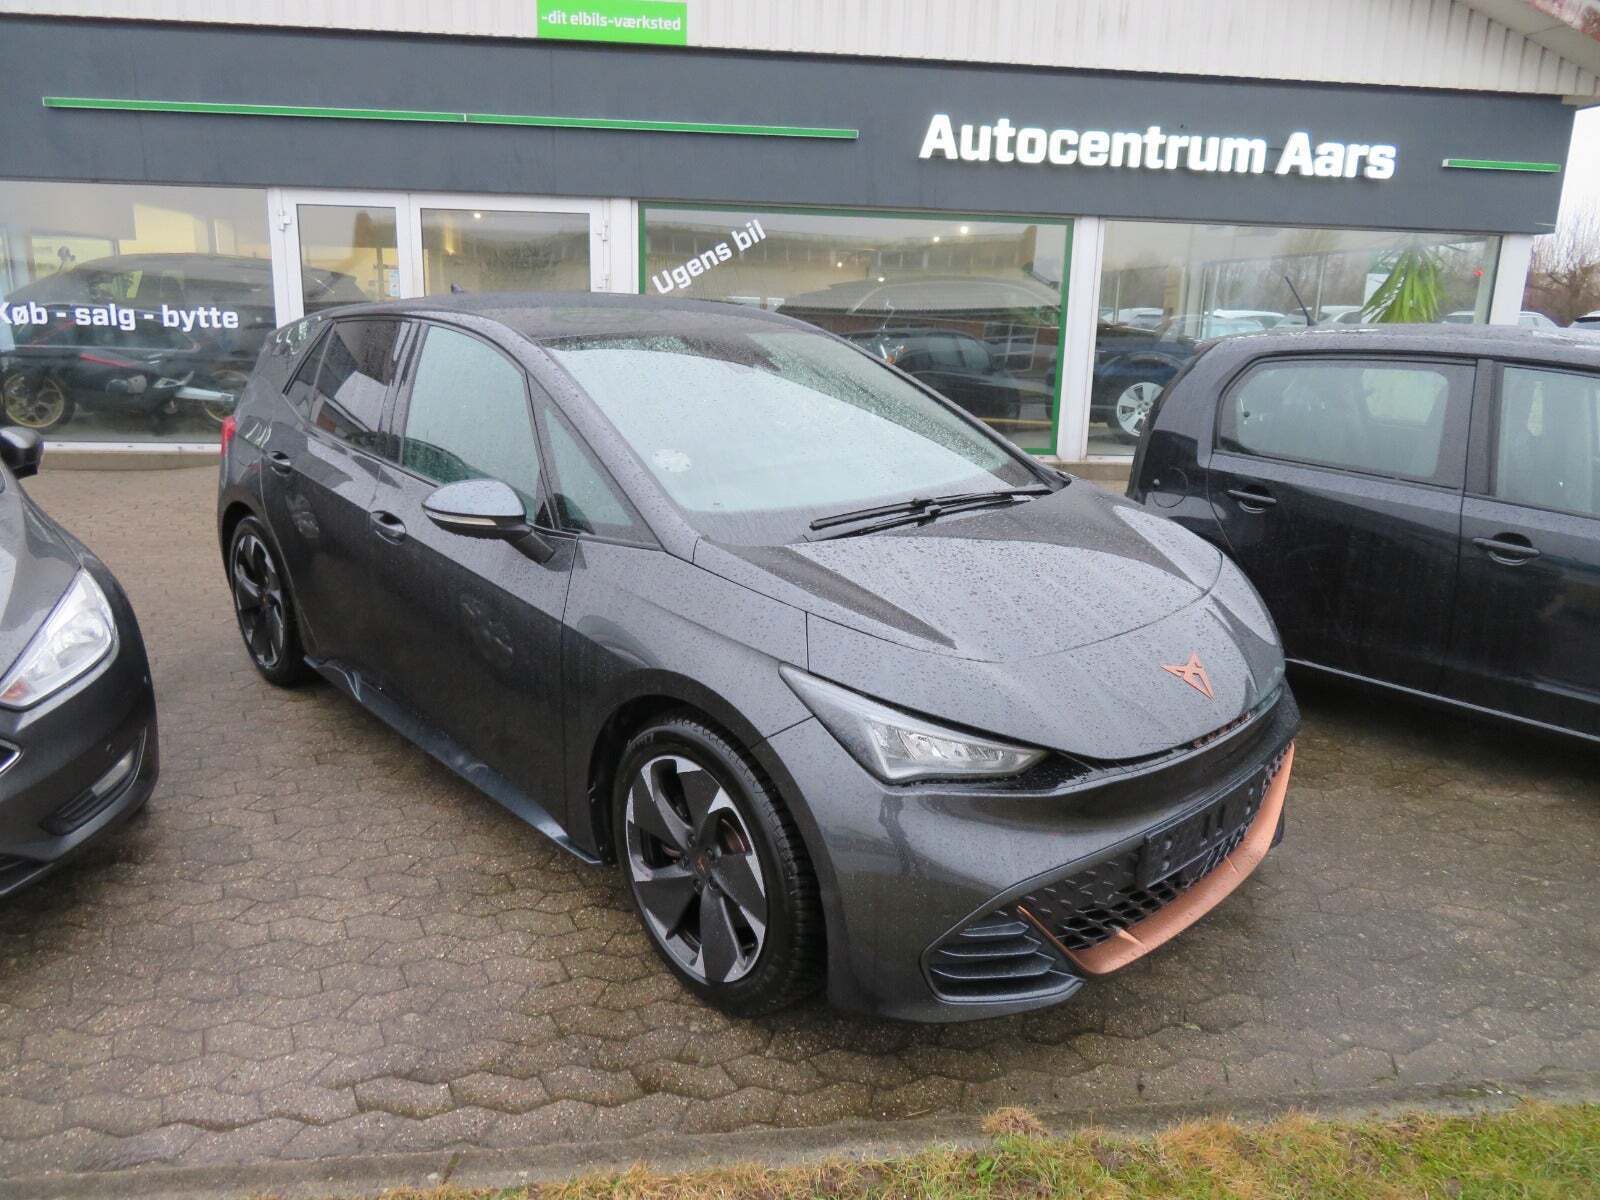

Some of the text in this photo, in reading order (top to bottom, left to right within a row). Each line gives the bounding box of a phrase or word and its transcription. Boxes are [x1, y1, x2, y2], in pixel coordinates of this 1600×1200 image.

[542, 11, 681, 31] -dit elbils-værksted
[919, 113, 1396, 180] Autocentrum Aars
[652, 219, 767, 294] Ugens bil
[0, 301, 48, 325] Køb
[74, 303, 136, 331] salg
[161, 304, 239, 332] bytte
